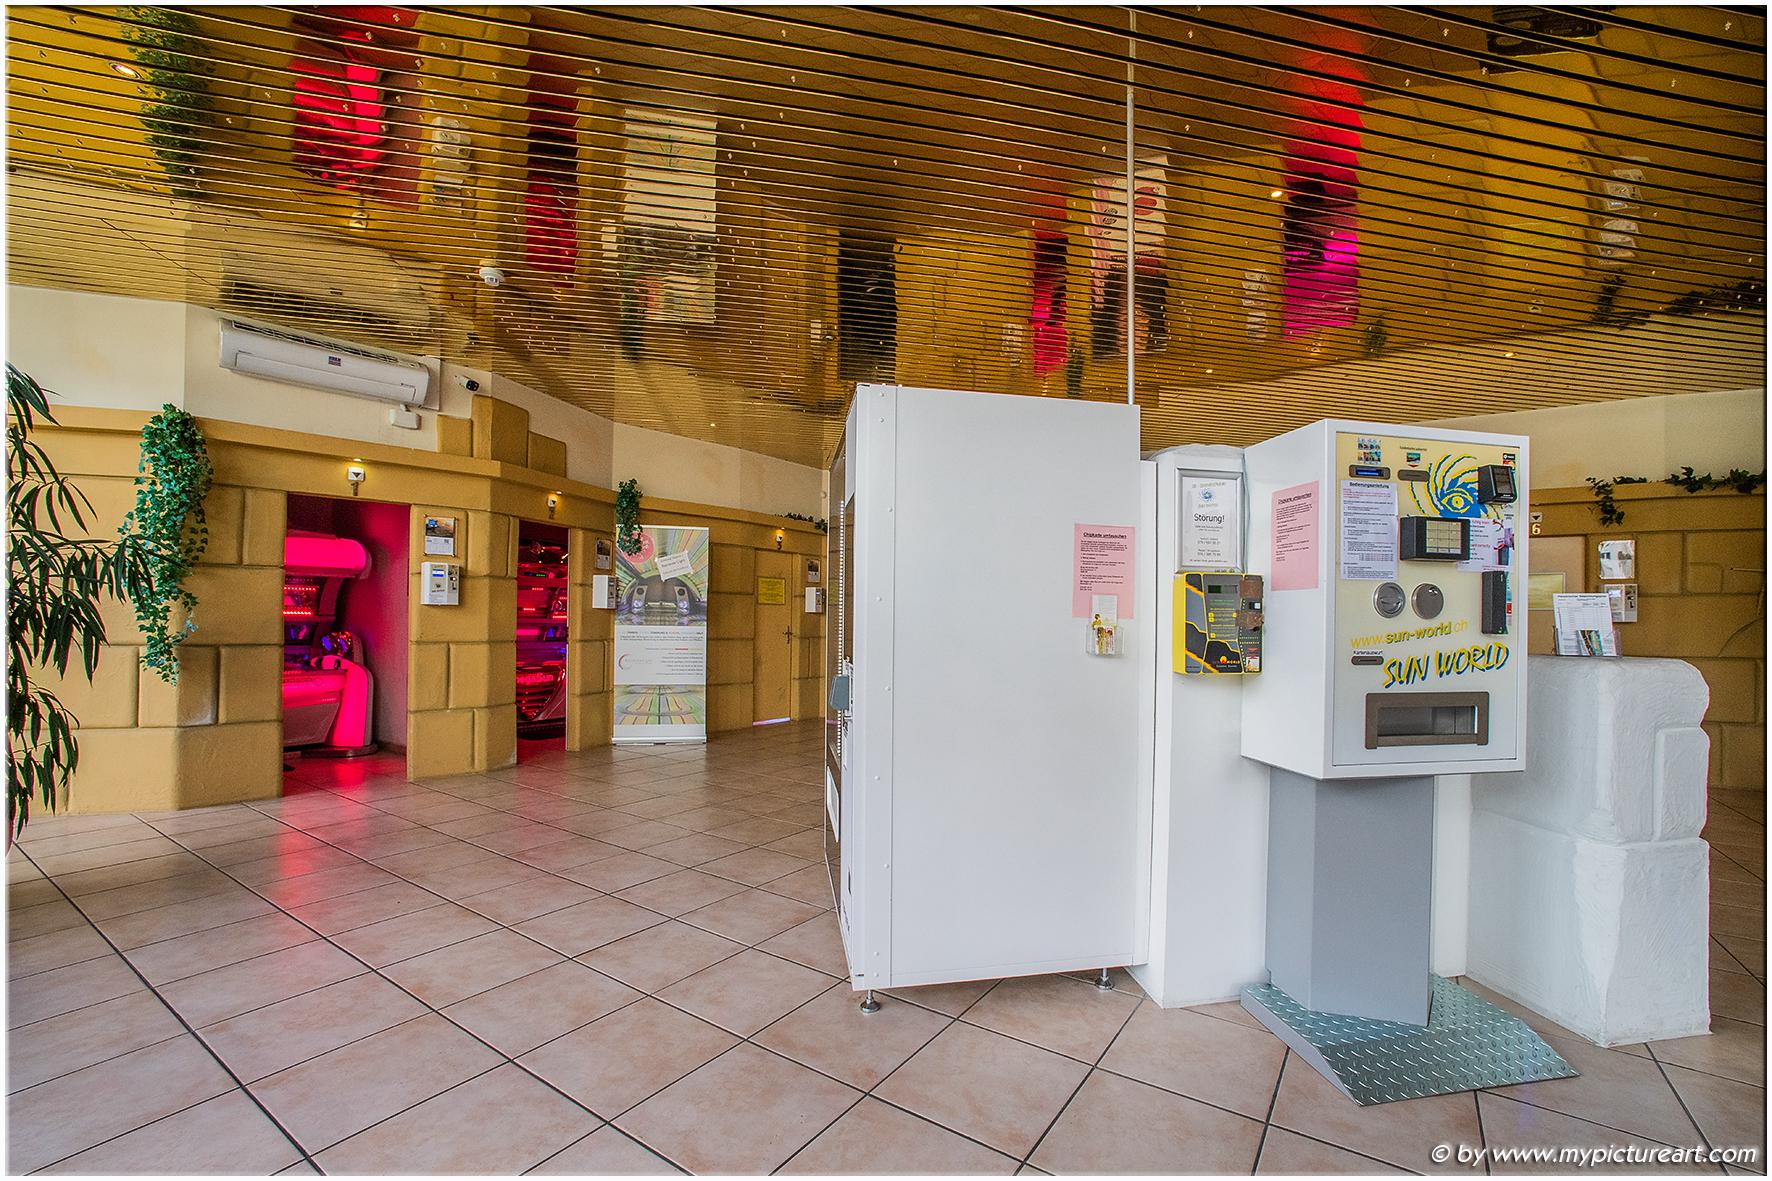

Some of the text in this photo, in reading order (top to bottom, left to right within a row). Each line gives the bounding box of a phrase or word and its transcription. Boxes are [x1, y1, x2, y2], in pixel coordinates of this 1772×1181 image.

[1193, 512, 1225, 524] Störung!
[1532, 523, 1541, 535] 6
[1351, 619, 1469, 649] www.sun-world.ch
[1382, 642, 1510, 689] SUN WORLD
